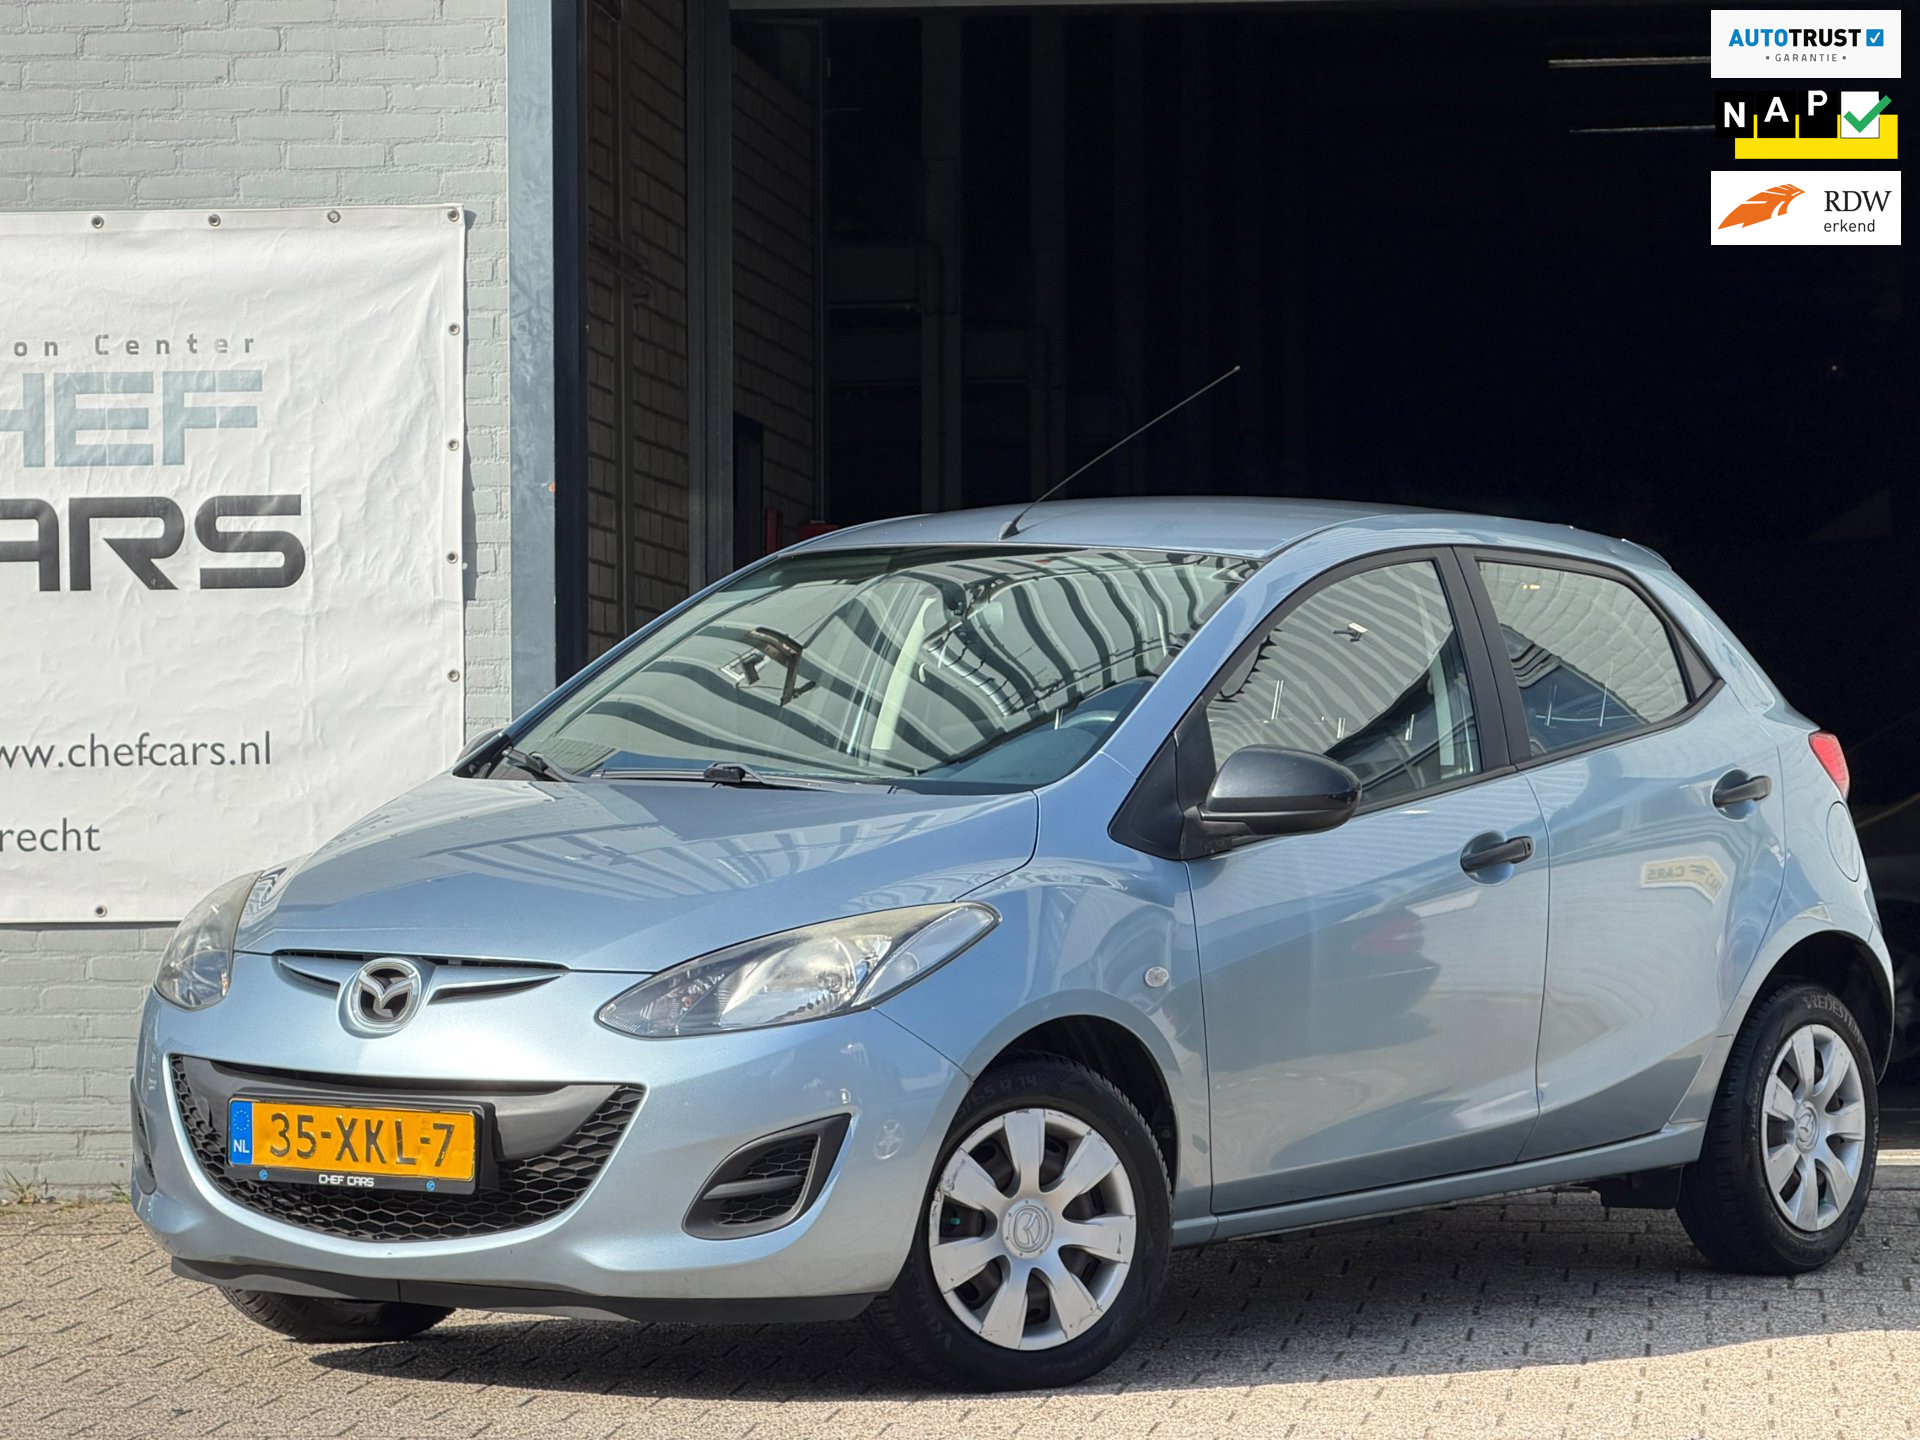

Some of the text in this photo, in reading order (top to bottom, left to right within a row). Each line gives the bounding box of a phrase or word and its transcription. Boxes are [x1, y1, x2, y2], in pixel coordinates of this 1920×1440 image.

[95, 334, 254, 356] Center
[0, 817, 101, 852] recht
[233, 1139, 250, 1154] NL
[269, 1112, 455, 1168] 35-XKL-7
[318, 1173, 375, 1188] CHEF CARS
